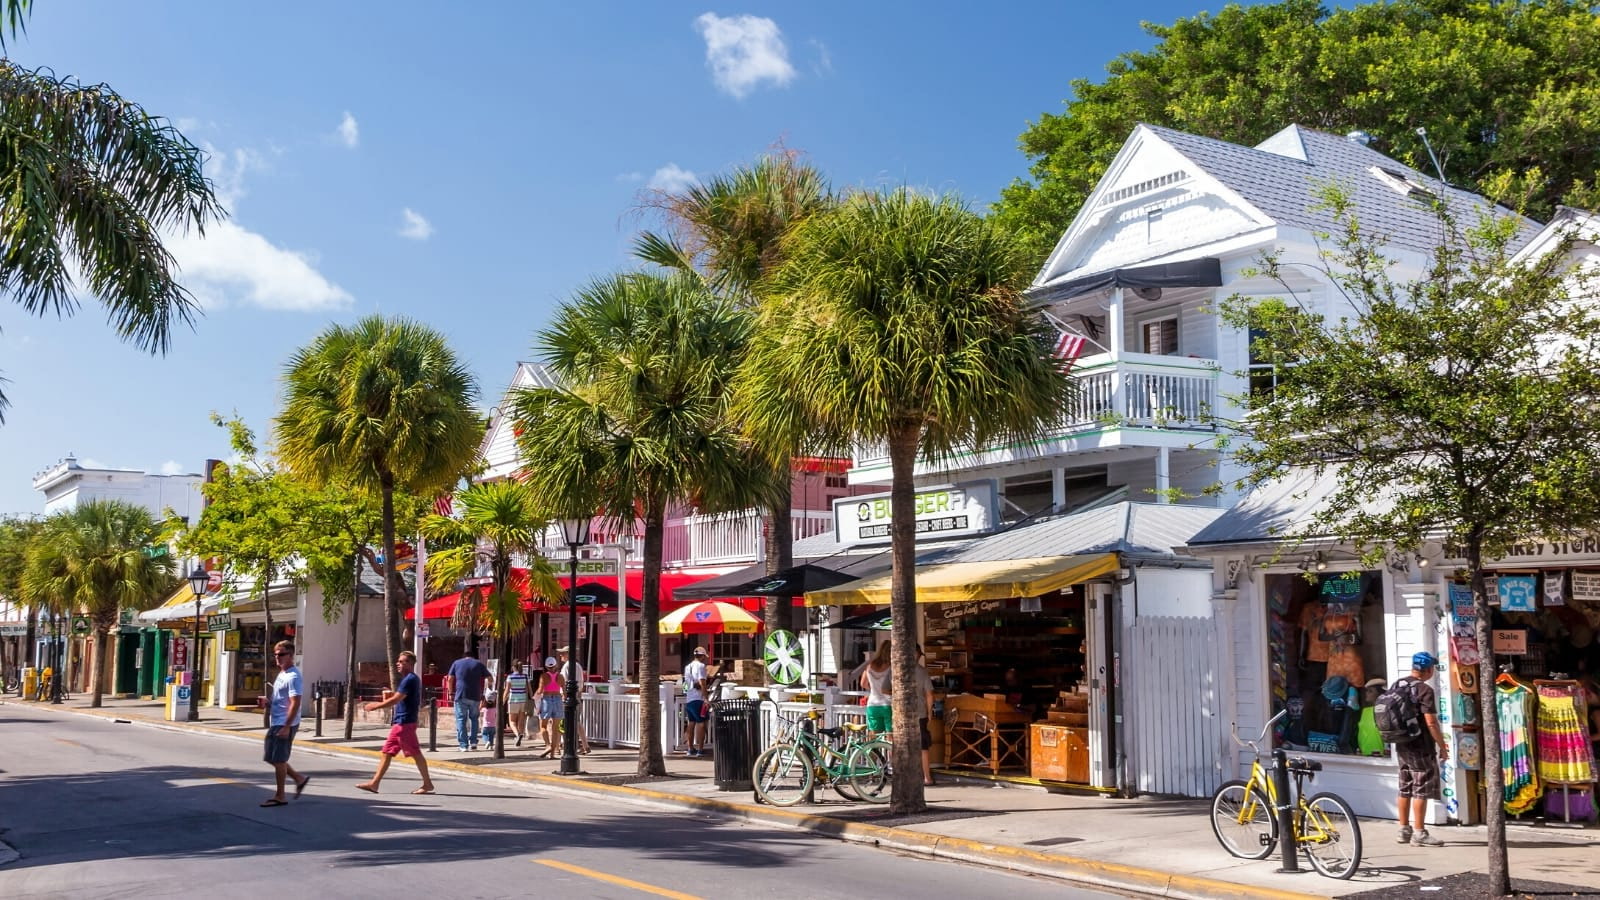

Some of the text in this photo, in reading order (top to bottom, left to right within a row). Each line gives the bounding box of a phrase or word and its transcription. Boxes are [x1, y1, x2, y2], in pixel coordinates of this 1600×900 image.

[874, 490, 967, 519] BUGERFI
[1322, 580, 1360, 593] ATM
[208, 614, 231, 626] ATM
